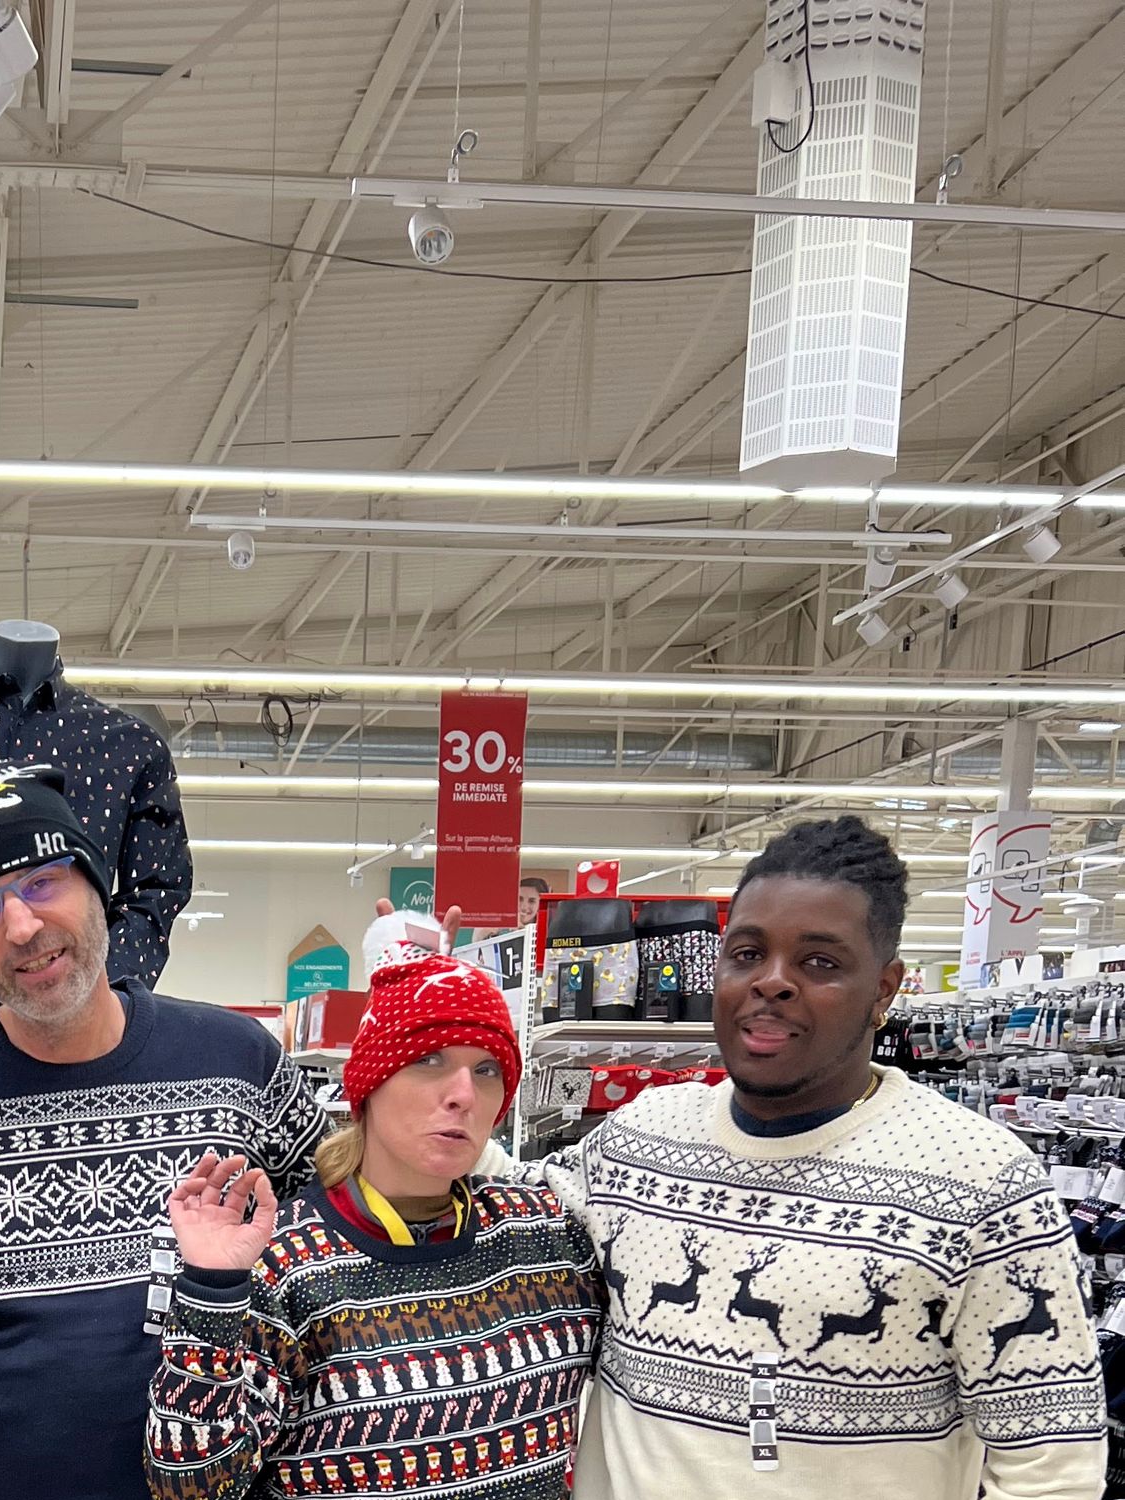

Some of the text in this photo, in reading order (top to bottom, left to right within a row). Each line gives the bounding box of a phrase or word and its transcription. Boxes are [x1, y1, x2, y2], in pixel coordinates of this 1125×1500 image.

[442, 730, 523, 774] 30%
[454, 783, 505, 793] DE REMISE
[452, 793, 508, 803] IMMEDIATE
[552, 937, 582, 948] HOMER
[157, 1239, 170, 1248] XL
[155, 1275, 168, 1284] XL
[151, 1312, 162, 1322] XL
[757, 1367, 771, 1376] XL
[756, 1408, 770, 1417] XL
[758, 1448, 773, 1457] XL
